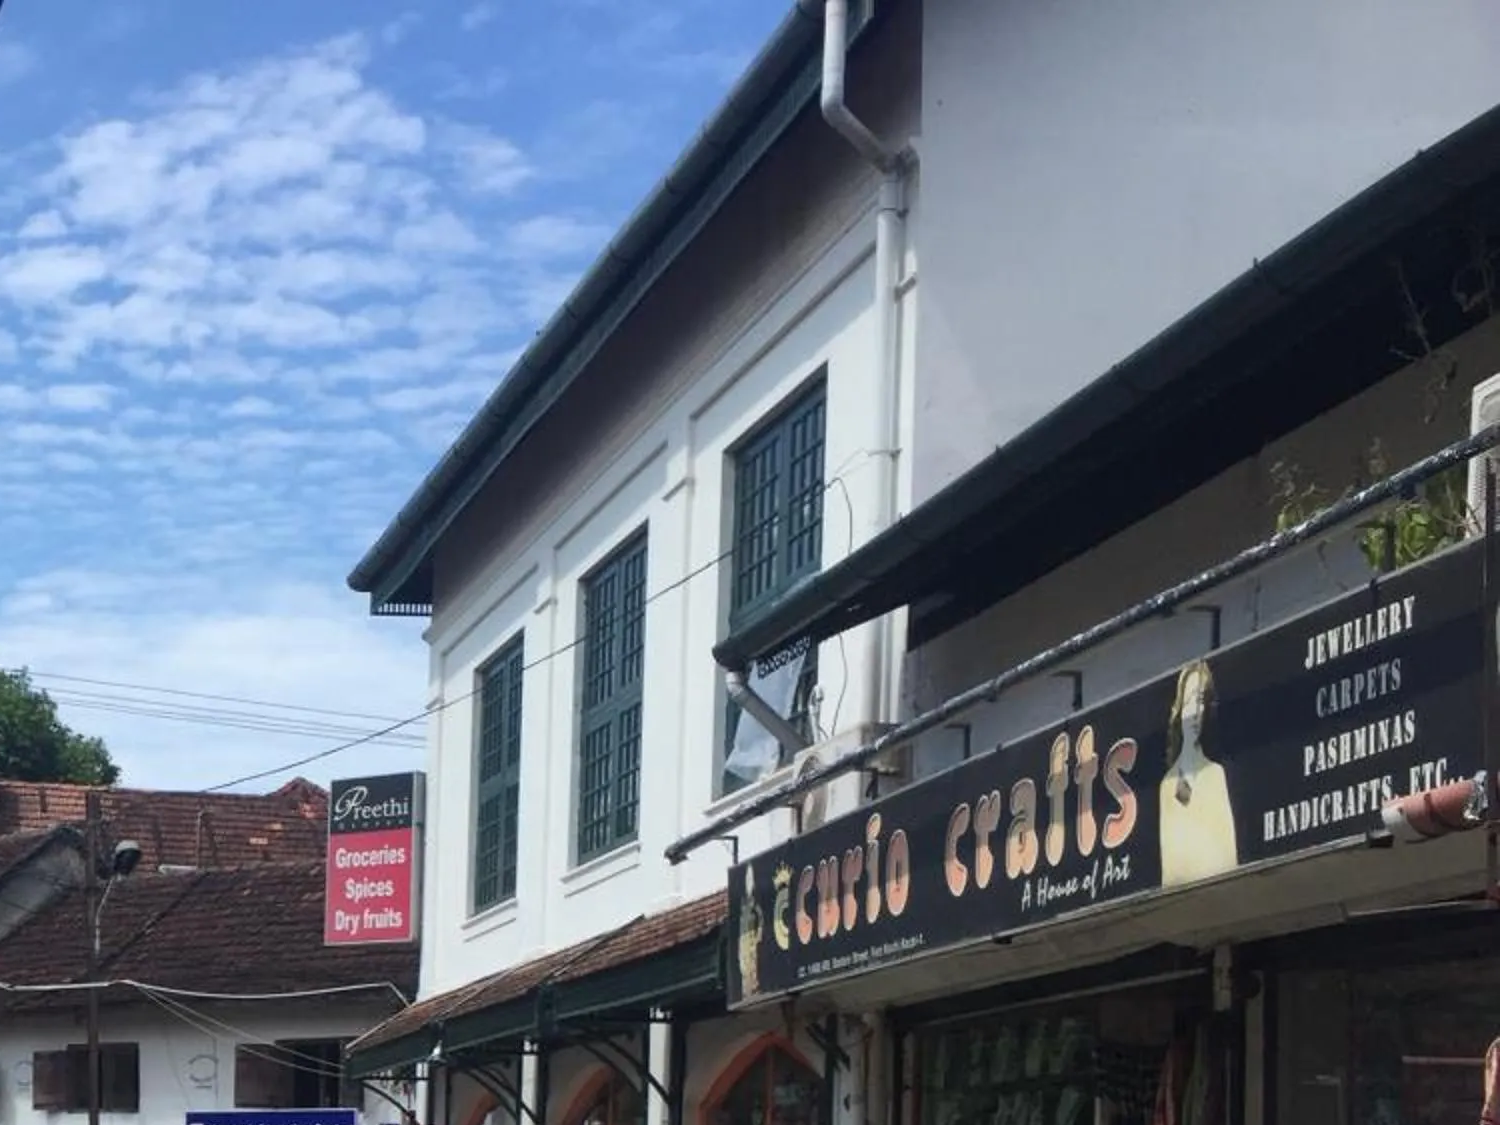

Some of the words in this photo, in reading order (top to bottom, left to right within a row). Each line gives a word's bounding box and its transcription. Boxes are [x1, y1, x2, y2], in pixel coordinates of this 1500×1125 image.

[1304, 596, 1416, 670] JEWELLERY
[1315, 658, 1402, 718] CARPETS
[1303, 709, 1417, 777] PASHMINAS
[333, 785, 409, 821] Preethi
[335, 845, 405, 868] Groceries
[345, 876, 394, 903] Spices
[1021, 879, 1031, 912] A
[1037, 876, 1078, 908] House
[1082, 859, 1099, 899] of
[1102, 854, 1131, 889] Art
[335, 909, 359, 935] Dry
[363, 907, 402, 929] fruits
